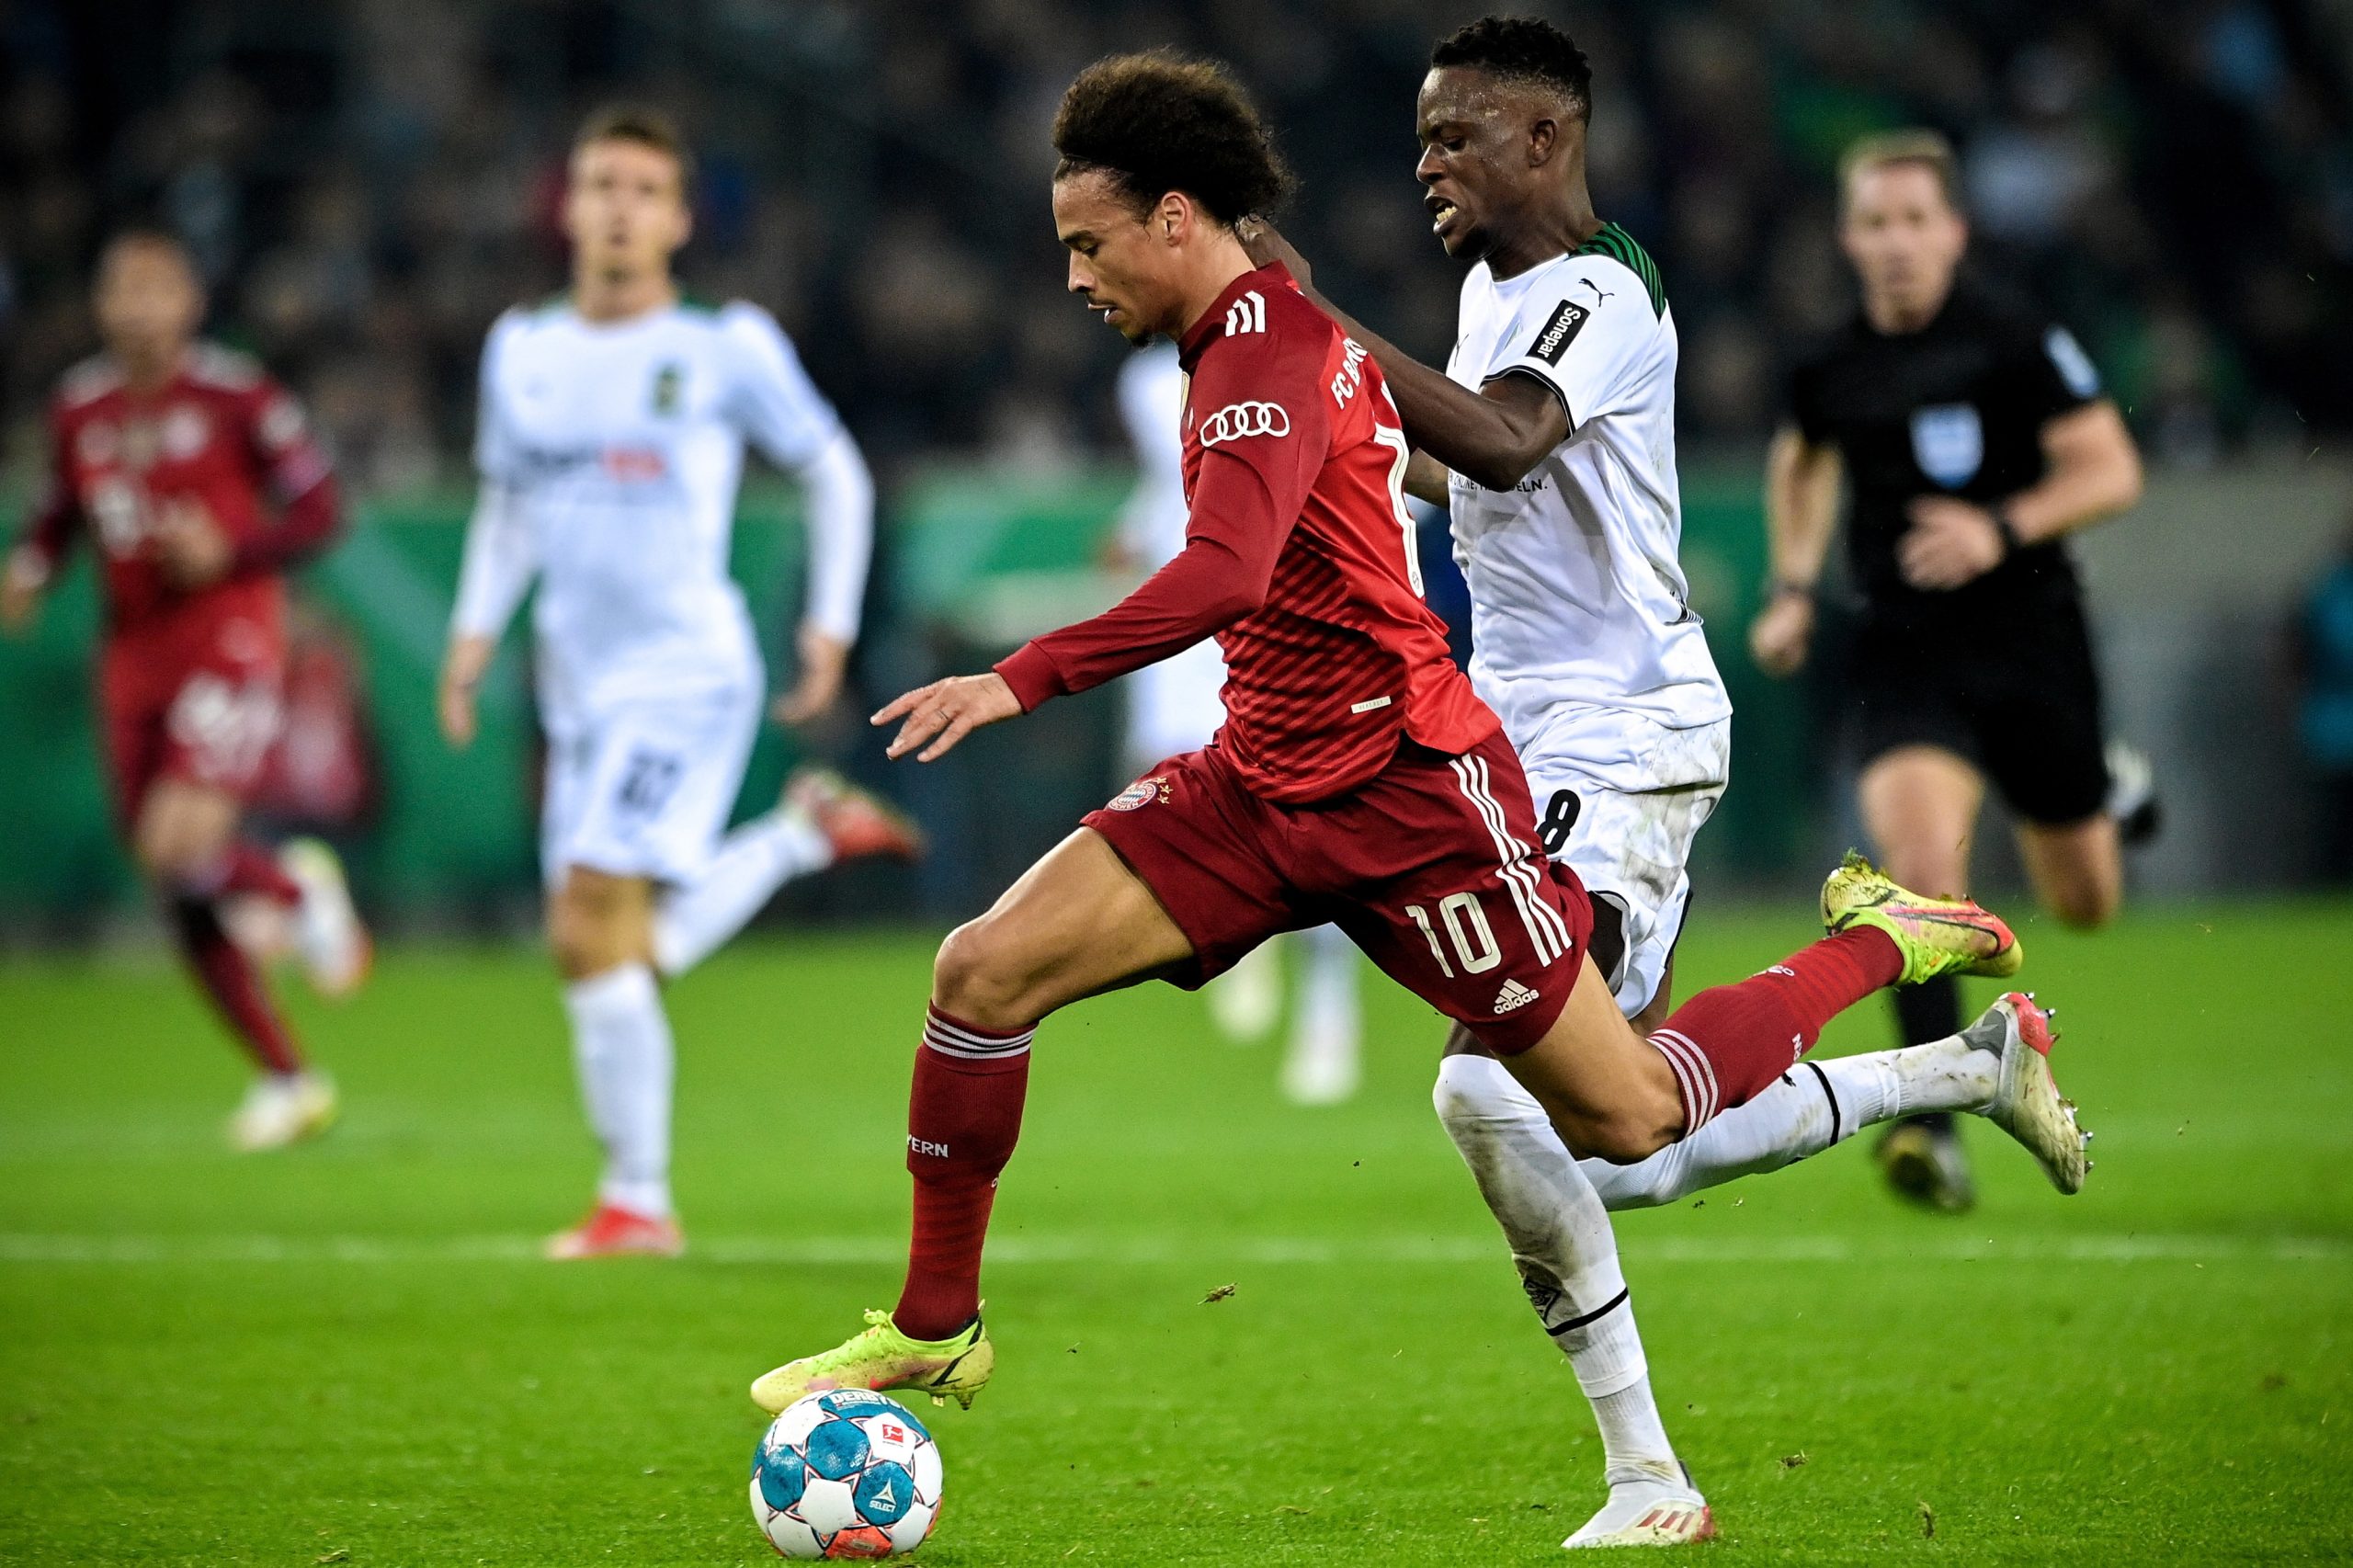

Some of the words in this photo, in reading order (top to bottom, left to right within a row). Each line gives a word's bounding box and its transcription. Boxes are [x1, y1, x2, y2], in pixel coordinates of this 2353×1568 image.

[1537, 307, 1582, 358] Sonepar
[1330, 371, 1354, 410] FC
[1535, 789, 1581, 855] 8
[1404, 892, 1502, 978] 10
[1494, 989, 1540, 1015] adidas
[869, 1500, 896, 1513] SELECT
